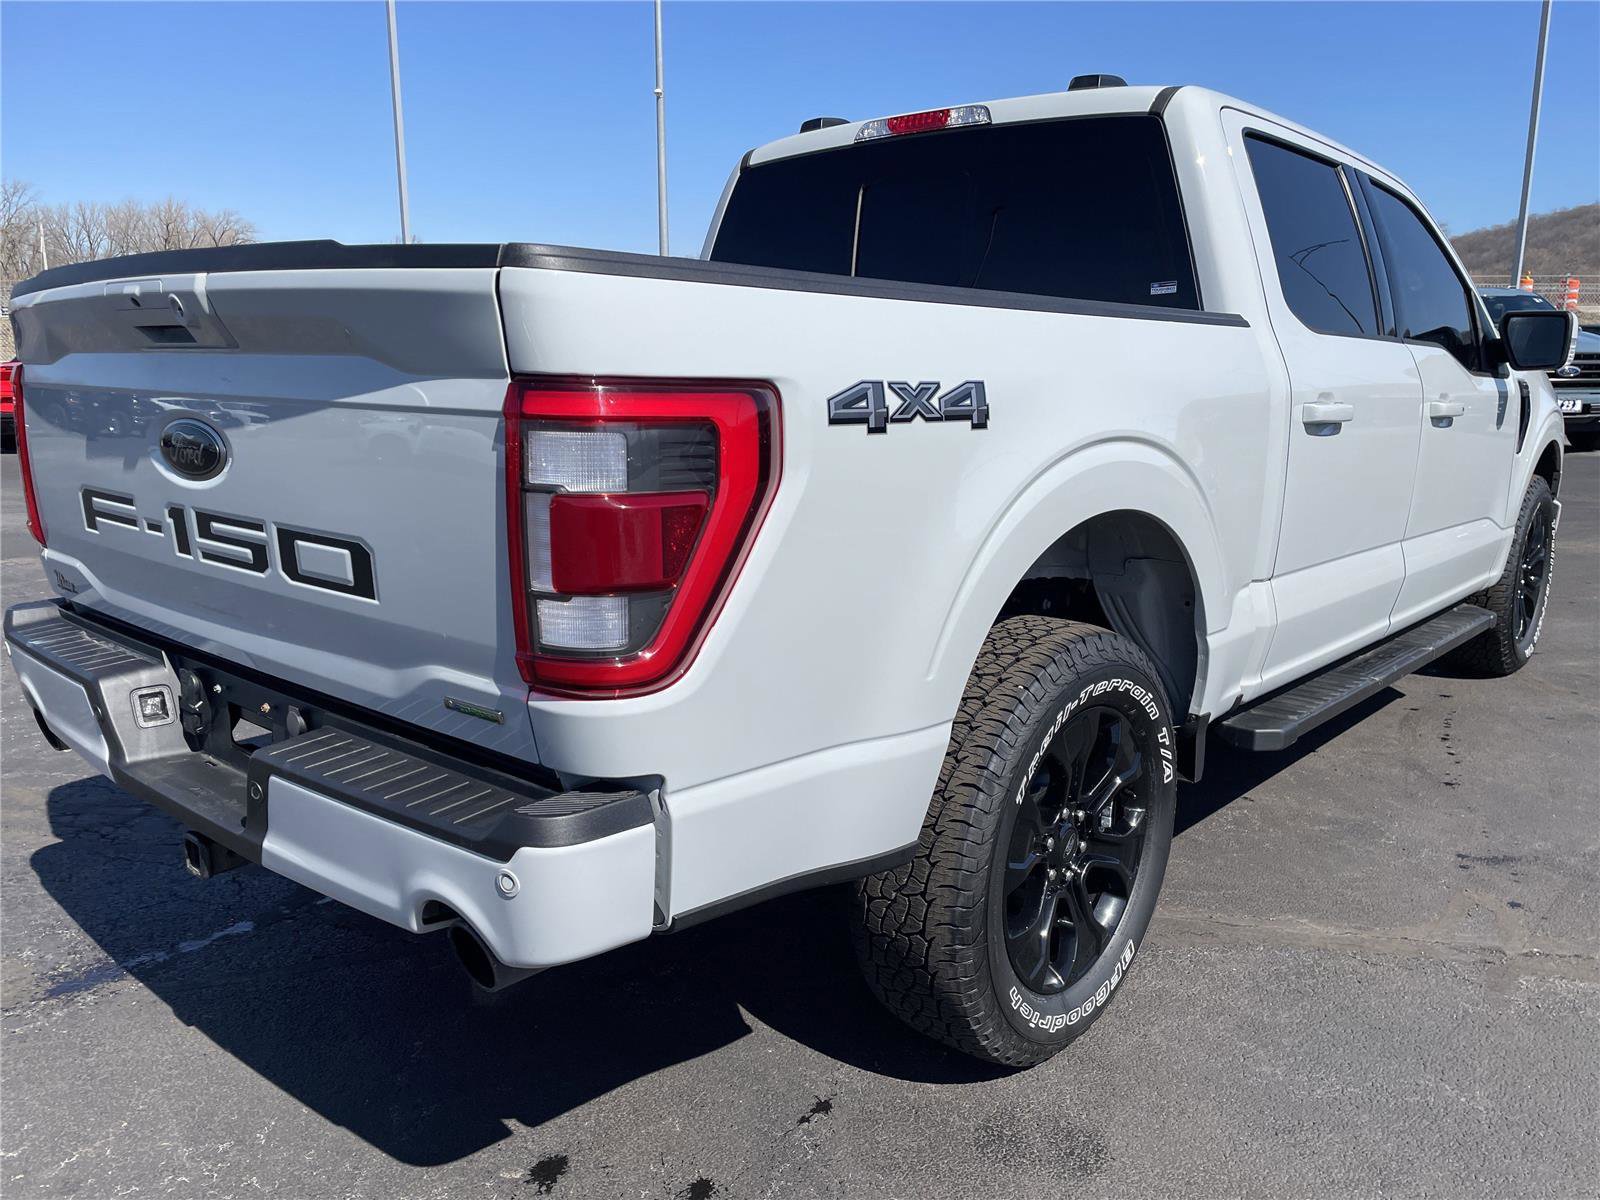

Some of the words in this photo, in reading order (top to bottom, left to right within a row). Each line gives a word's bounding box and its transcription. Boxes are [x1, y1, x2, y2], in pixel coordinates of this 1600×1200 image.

[169, 431, 206, 467] Ford
[79, 485, 379, 604] F-150
[1008, 938, 1136, 1033] BFGoodrich
